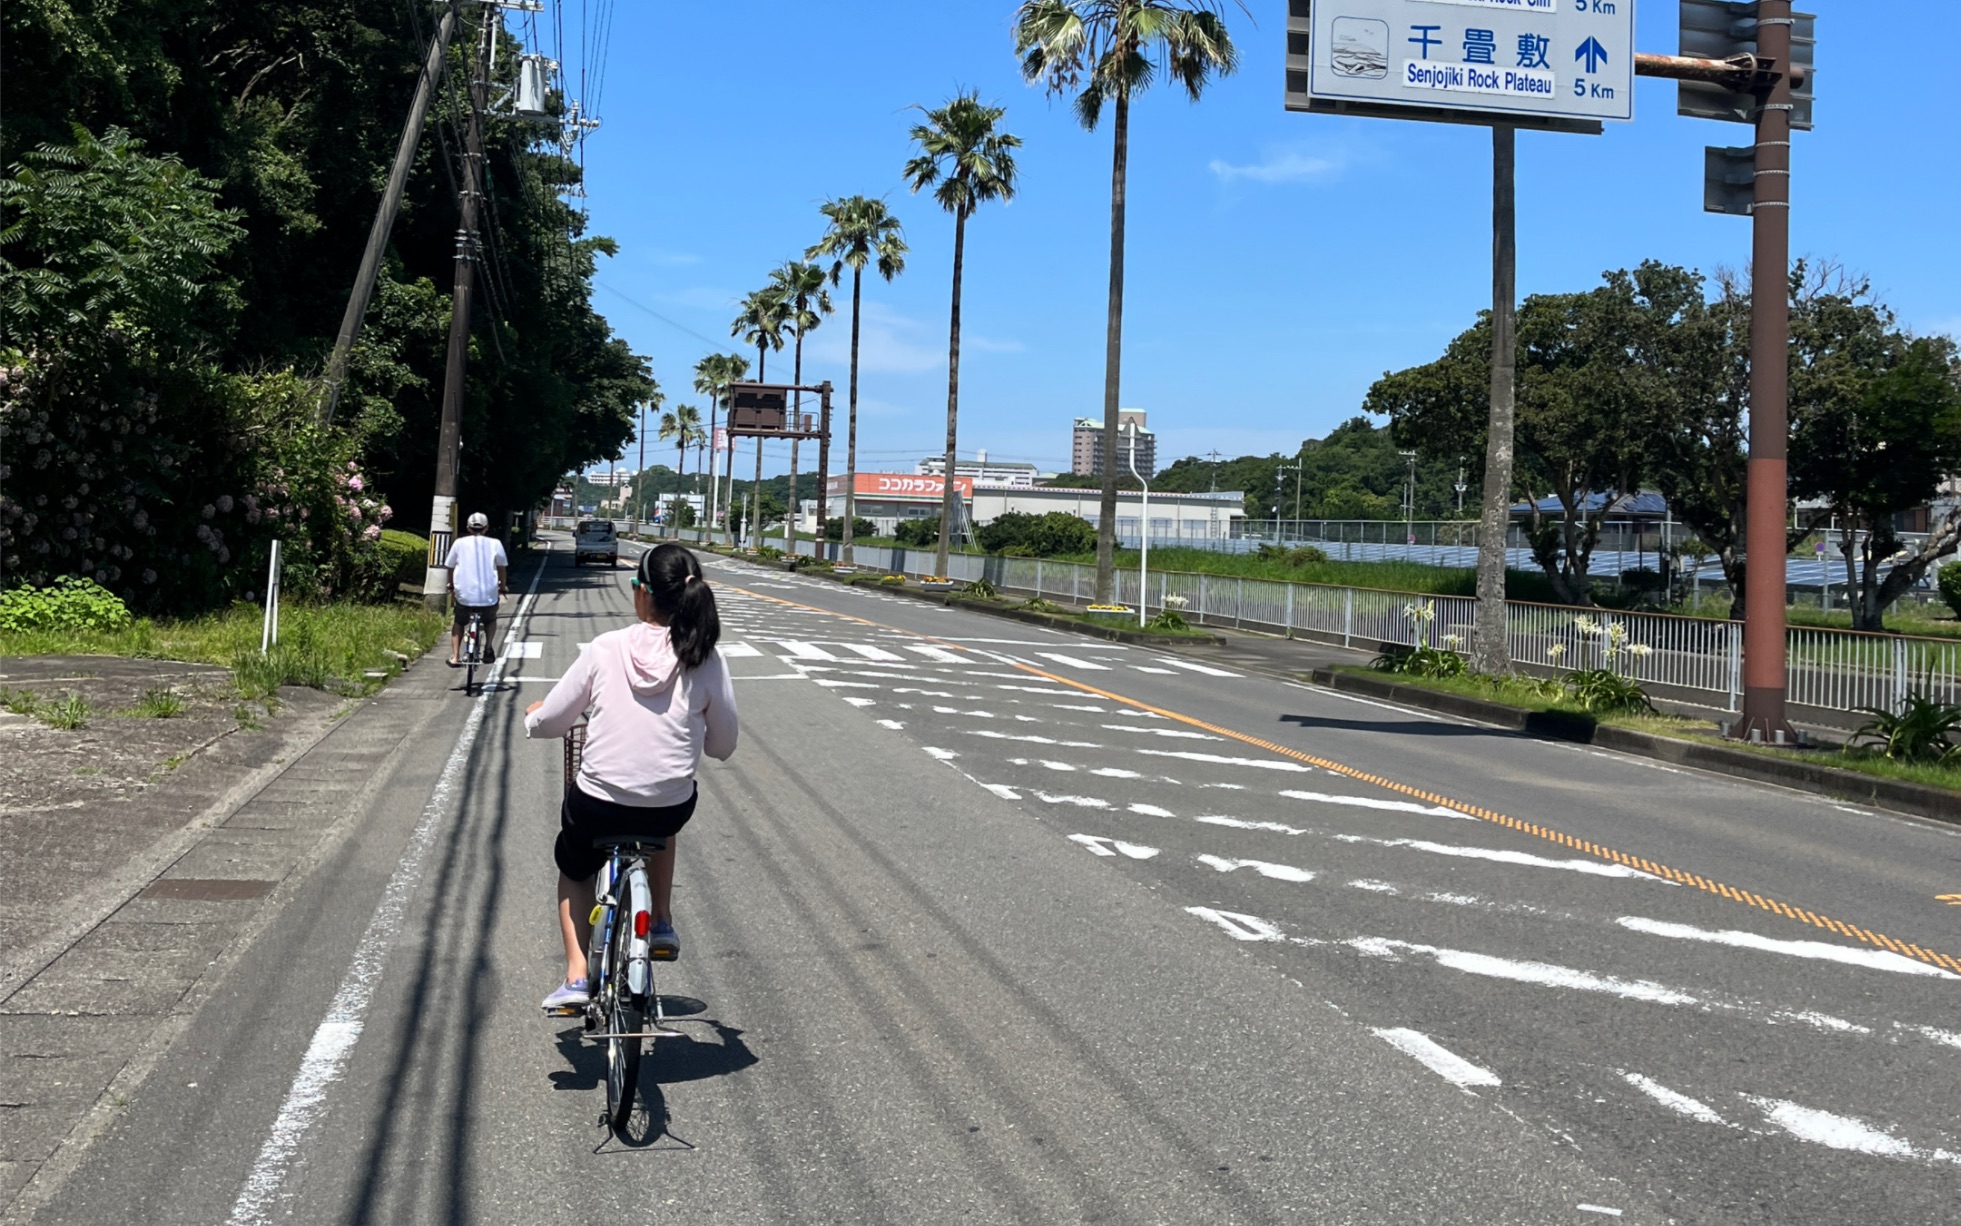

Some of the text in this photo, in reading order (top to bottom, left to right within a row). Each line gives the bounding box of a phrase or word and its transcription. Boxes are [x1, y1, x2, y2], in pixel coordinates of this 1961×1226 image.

[1575, 0, 1616, 15] 5 Km
[1407, 25, 1551, 70] 千畳敷
[1407, 63, 1552, 94] Senjojiki Rock Plateau
[1573, 78, 1614, 99] 5 Km
[878, 478, 967, 493] ココカラファン
